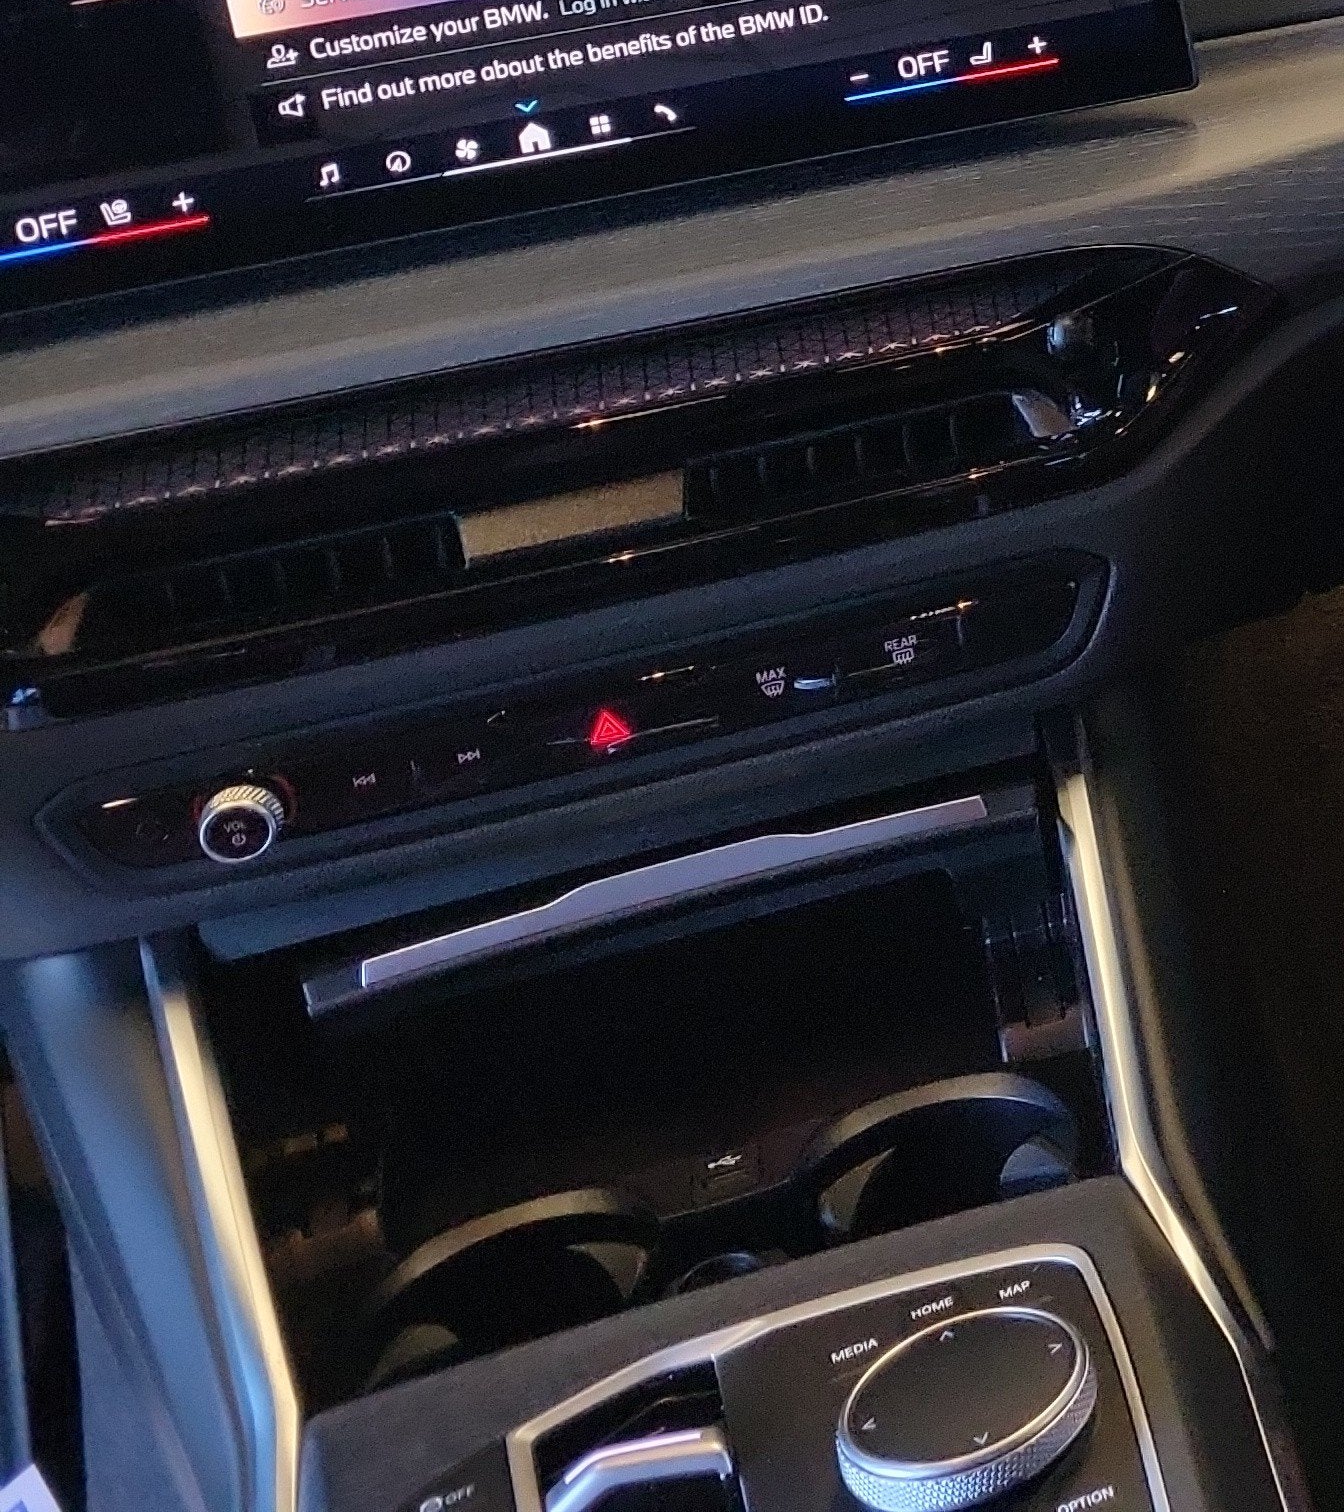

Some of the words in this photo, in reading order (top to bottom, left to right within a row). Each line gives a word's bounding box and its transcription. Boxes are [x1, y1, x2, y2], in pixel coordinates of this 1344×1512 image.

[310, 24, 427, 60] Customize
[430, 15, 479, 42] your
[483, 0, 550, 30] BMW.
[321, 82, 373, 111] Find
[378, 77, 415, 99] out
[418, 68, 476, 92] more
[481, 54, 545, 82] about
[548, 47, 584, 70] the
[587, 33, 672, 62] benefits
[676, 24, 697, 46] of
[700, 21, 736, 43] the
[739, 7, 796, 36] BMW
[799, 3, 829, 25] ID.
[898, 50, 950, 78] OFF
[15, 209, 77, 242] OFF
[884, 634, 918, 652] REAR
[755, 666, 788, 684] MAX
[998, 1280, 1031, 1300] MAP
[910, 1296, 954, 1321] HOME
[830, 1338, 879, 1365] MEDIA
[1057, 1485, 1114, 1512] OPTION
